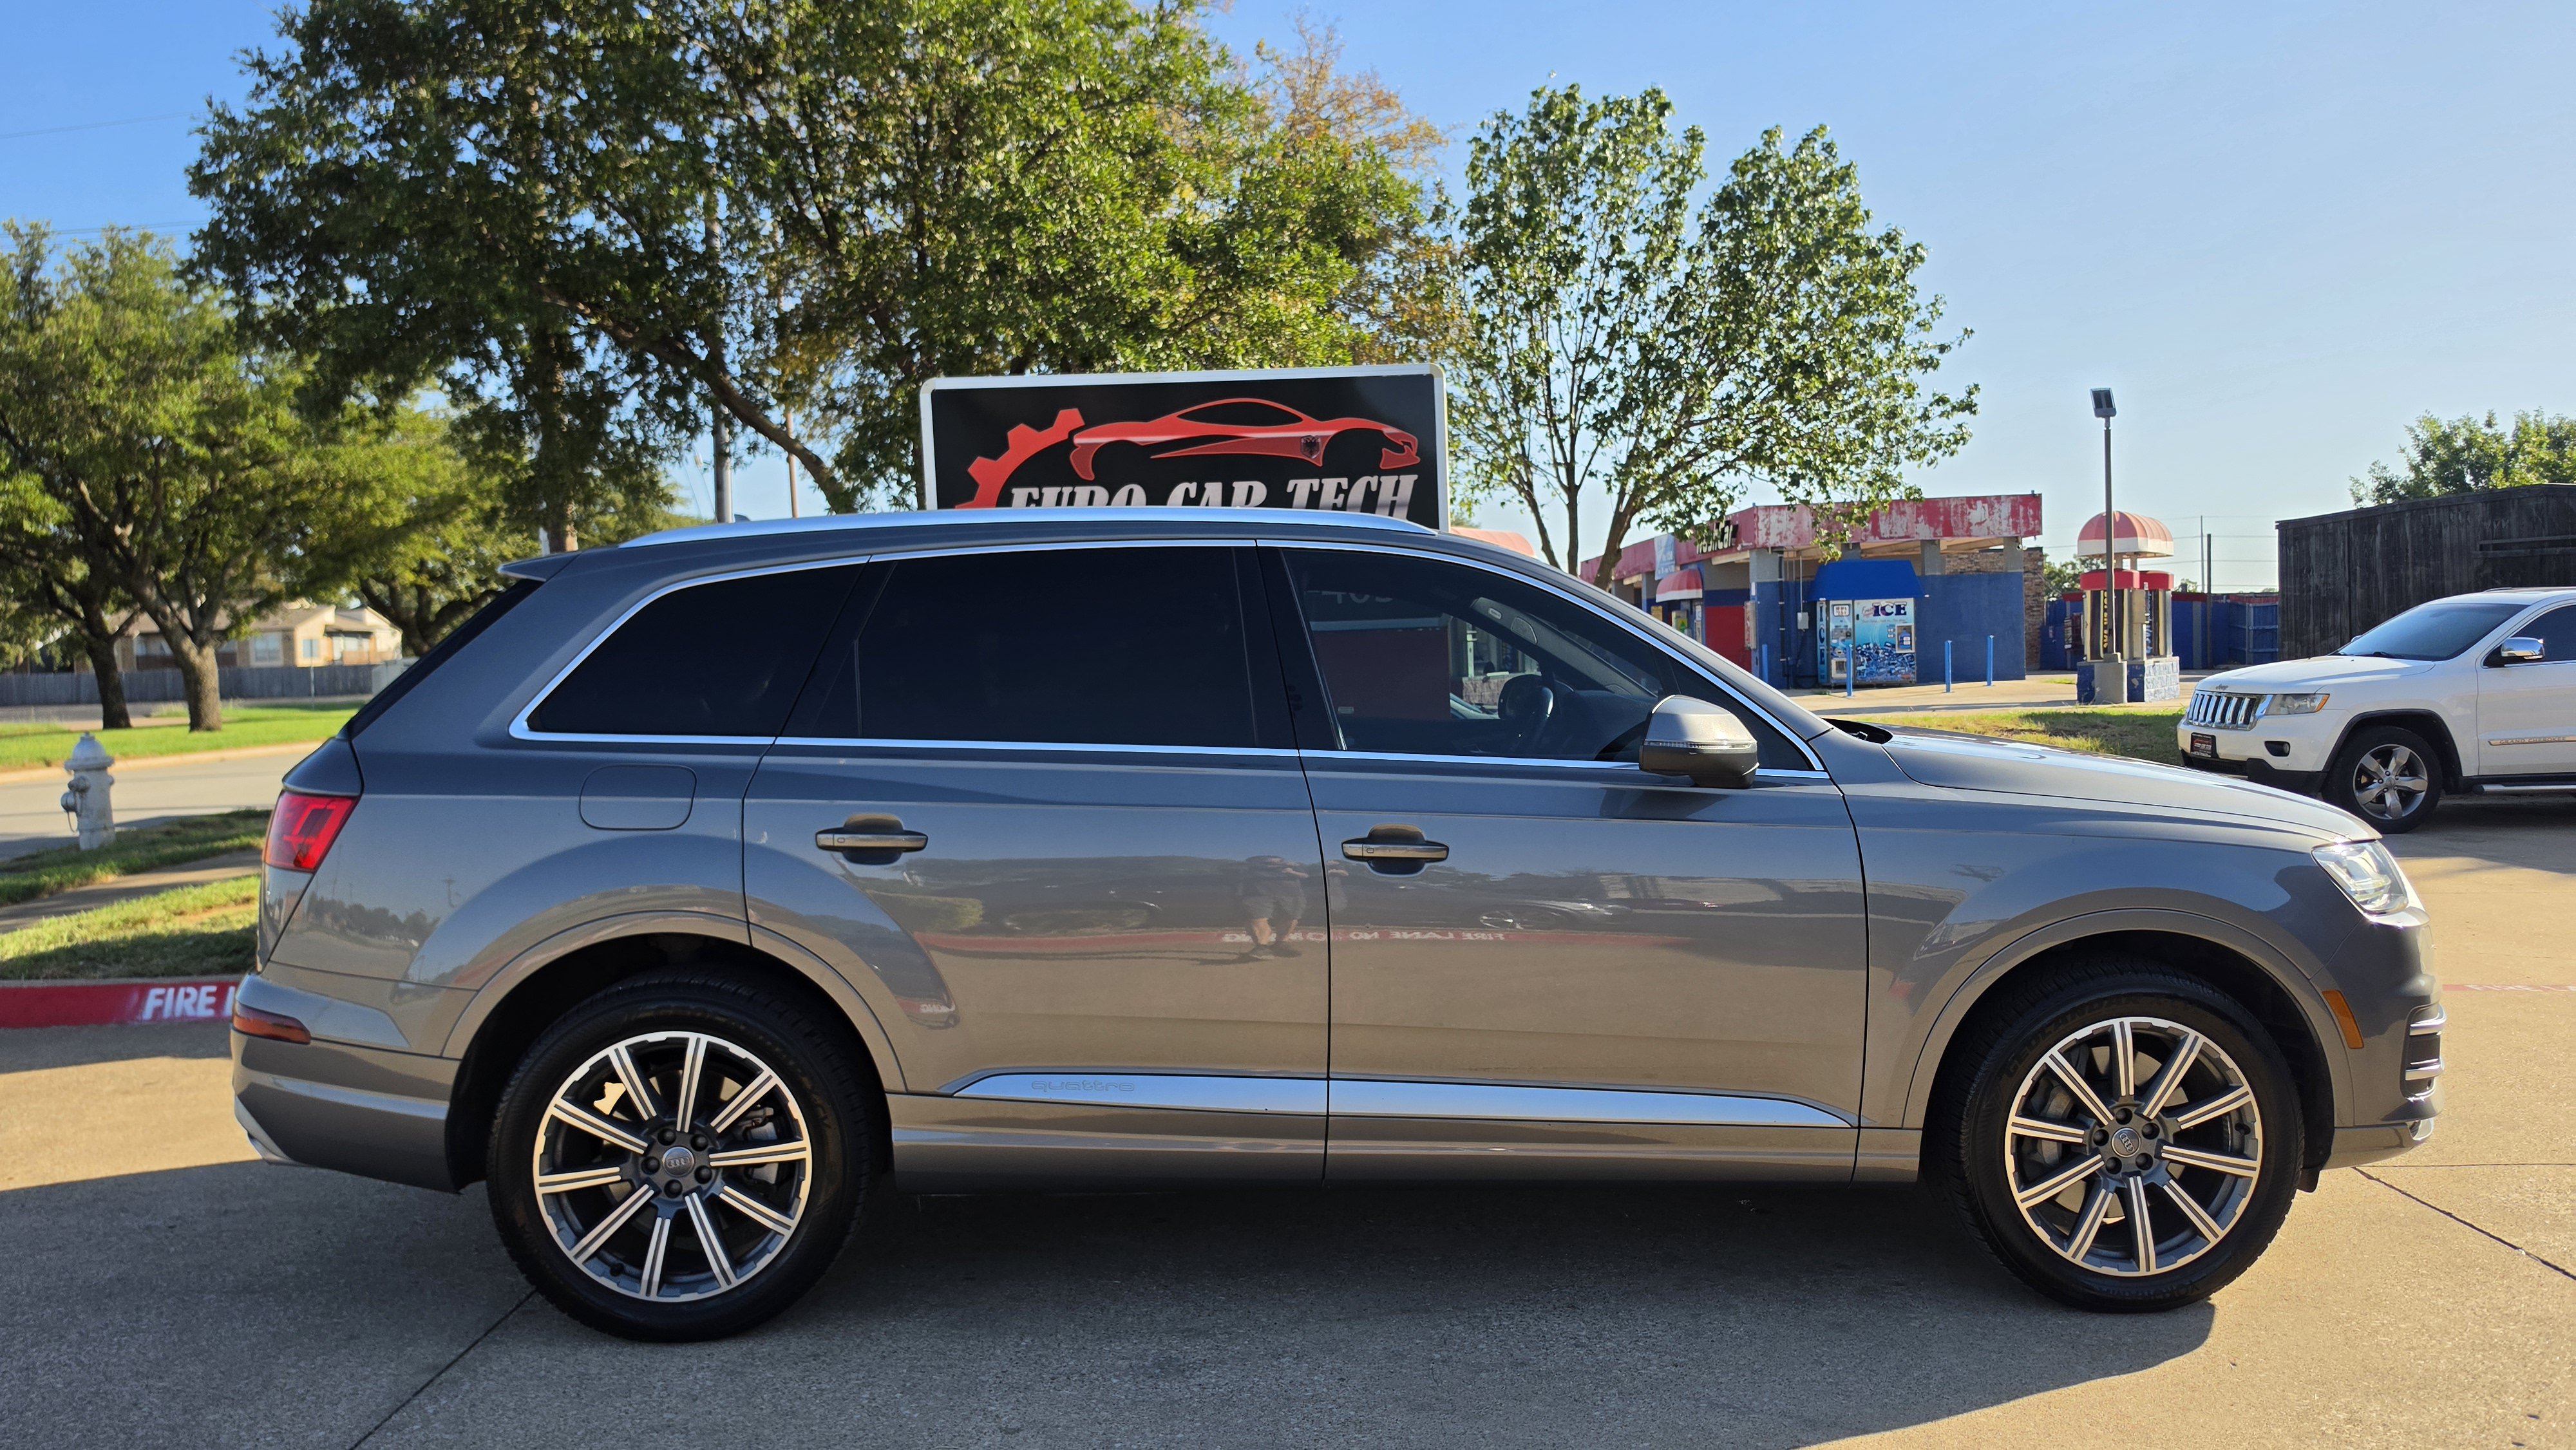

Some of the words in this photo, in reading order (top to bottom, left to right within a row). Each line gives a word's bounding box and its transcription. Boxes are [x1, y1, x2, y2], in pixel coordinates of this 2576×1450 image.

[1286, 474, 1419, 520] TECH
[1872, 601, 1907, 617] ICE
[142, 986, 217, 1020] FIRE
[1032, 1080, 1135, 1093] quattro
